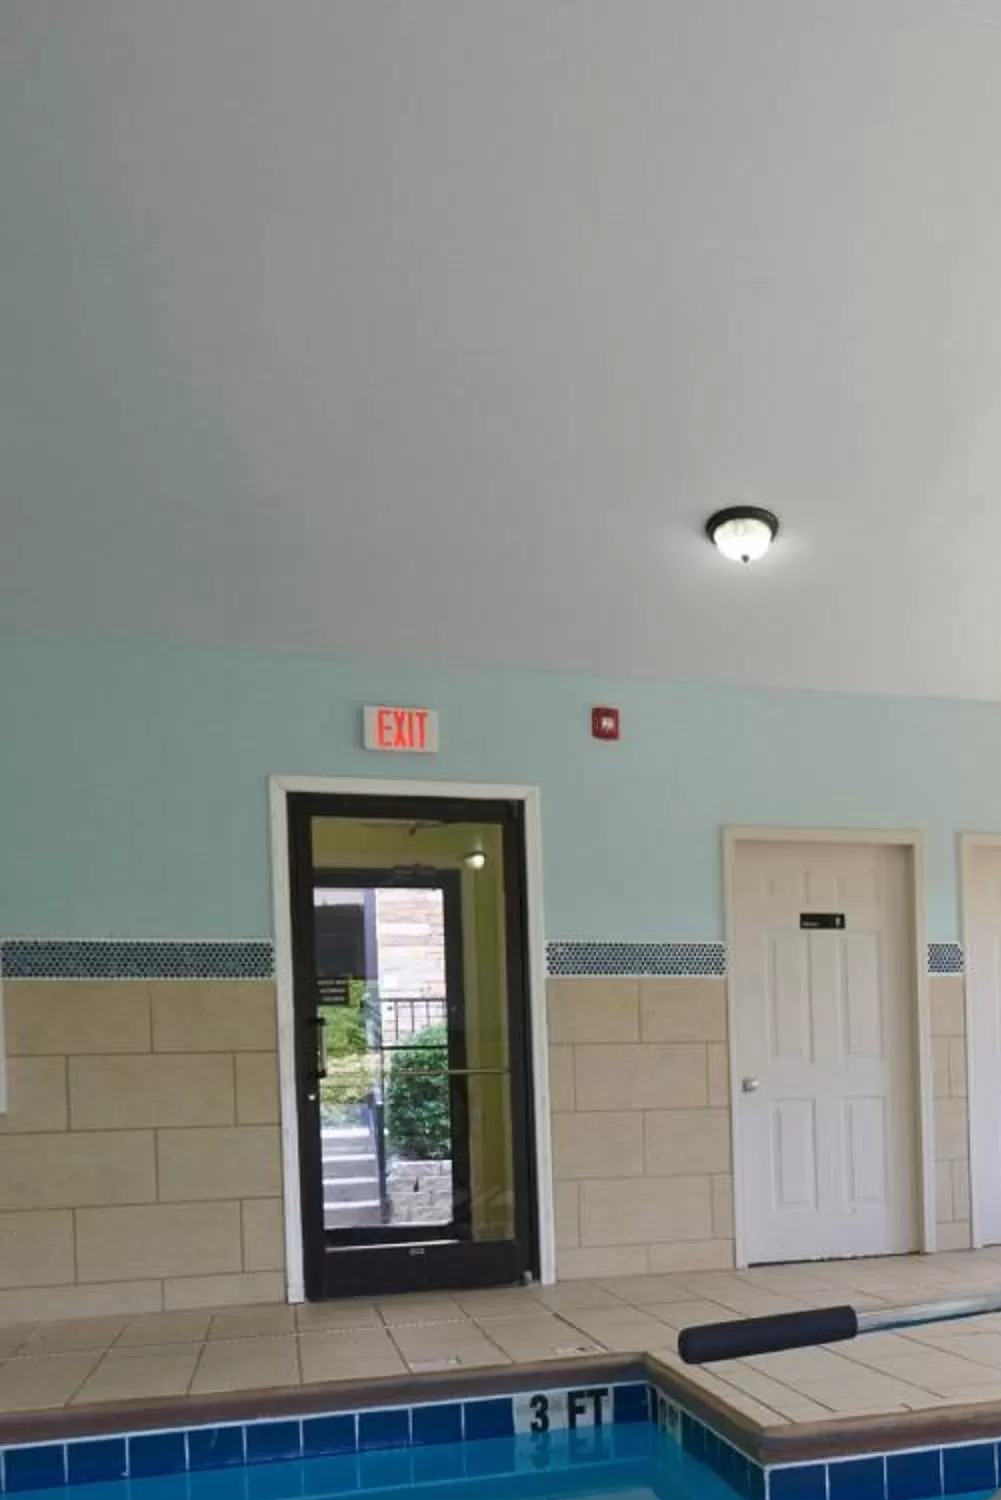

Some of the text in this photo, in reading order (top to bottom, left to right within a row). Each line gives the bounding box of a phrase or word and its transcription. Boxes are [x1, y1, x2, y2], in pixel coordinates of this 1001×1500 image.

[377, 708, 429, 749] EXIT
[529, 1387, 609, 1433] 3 FT
